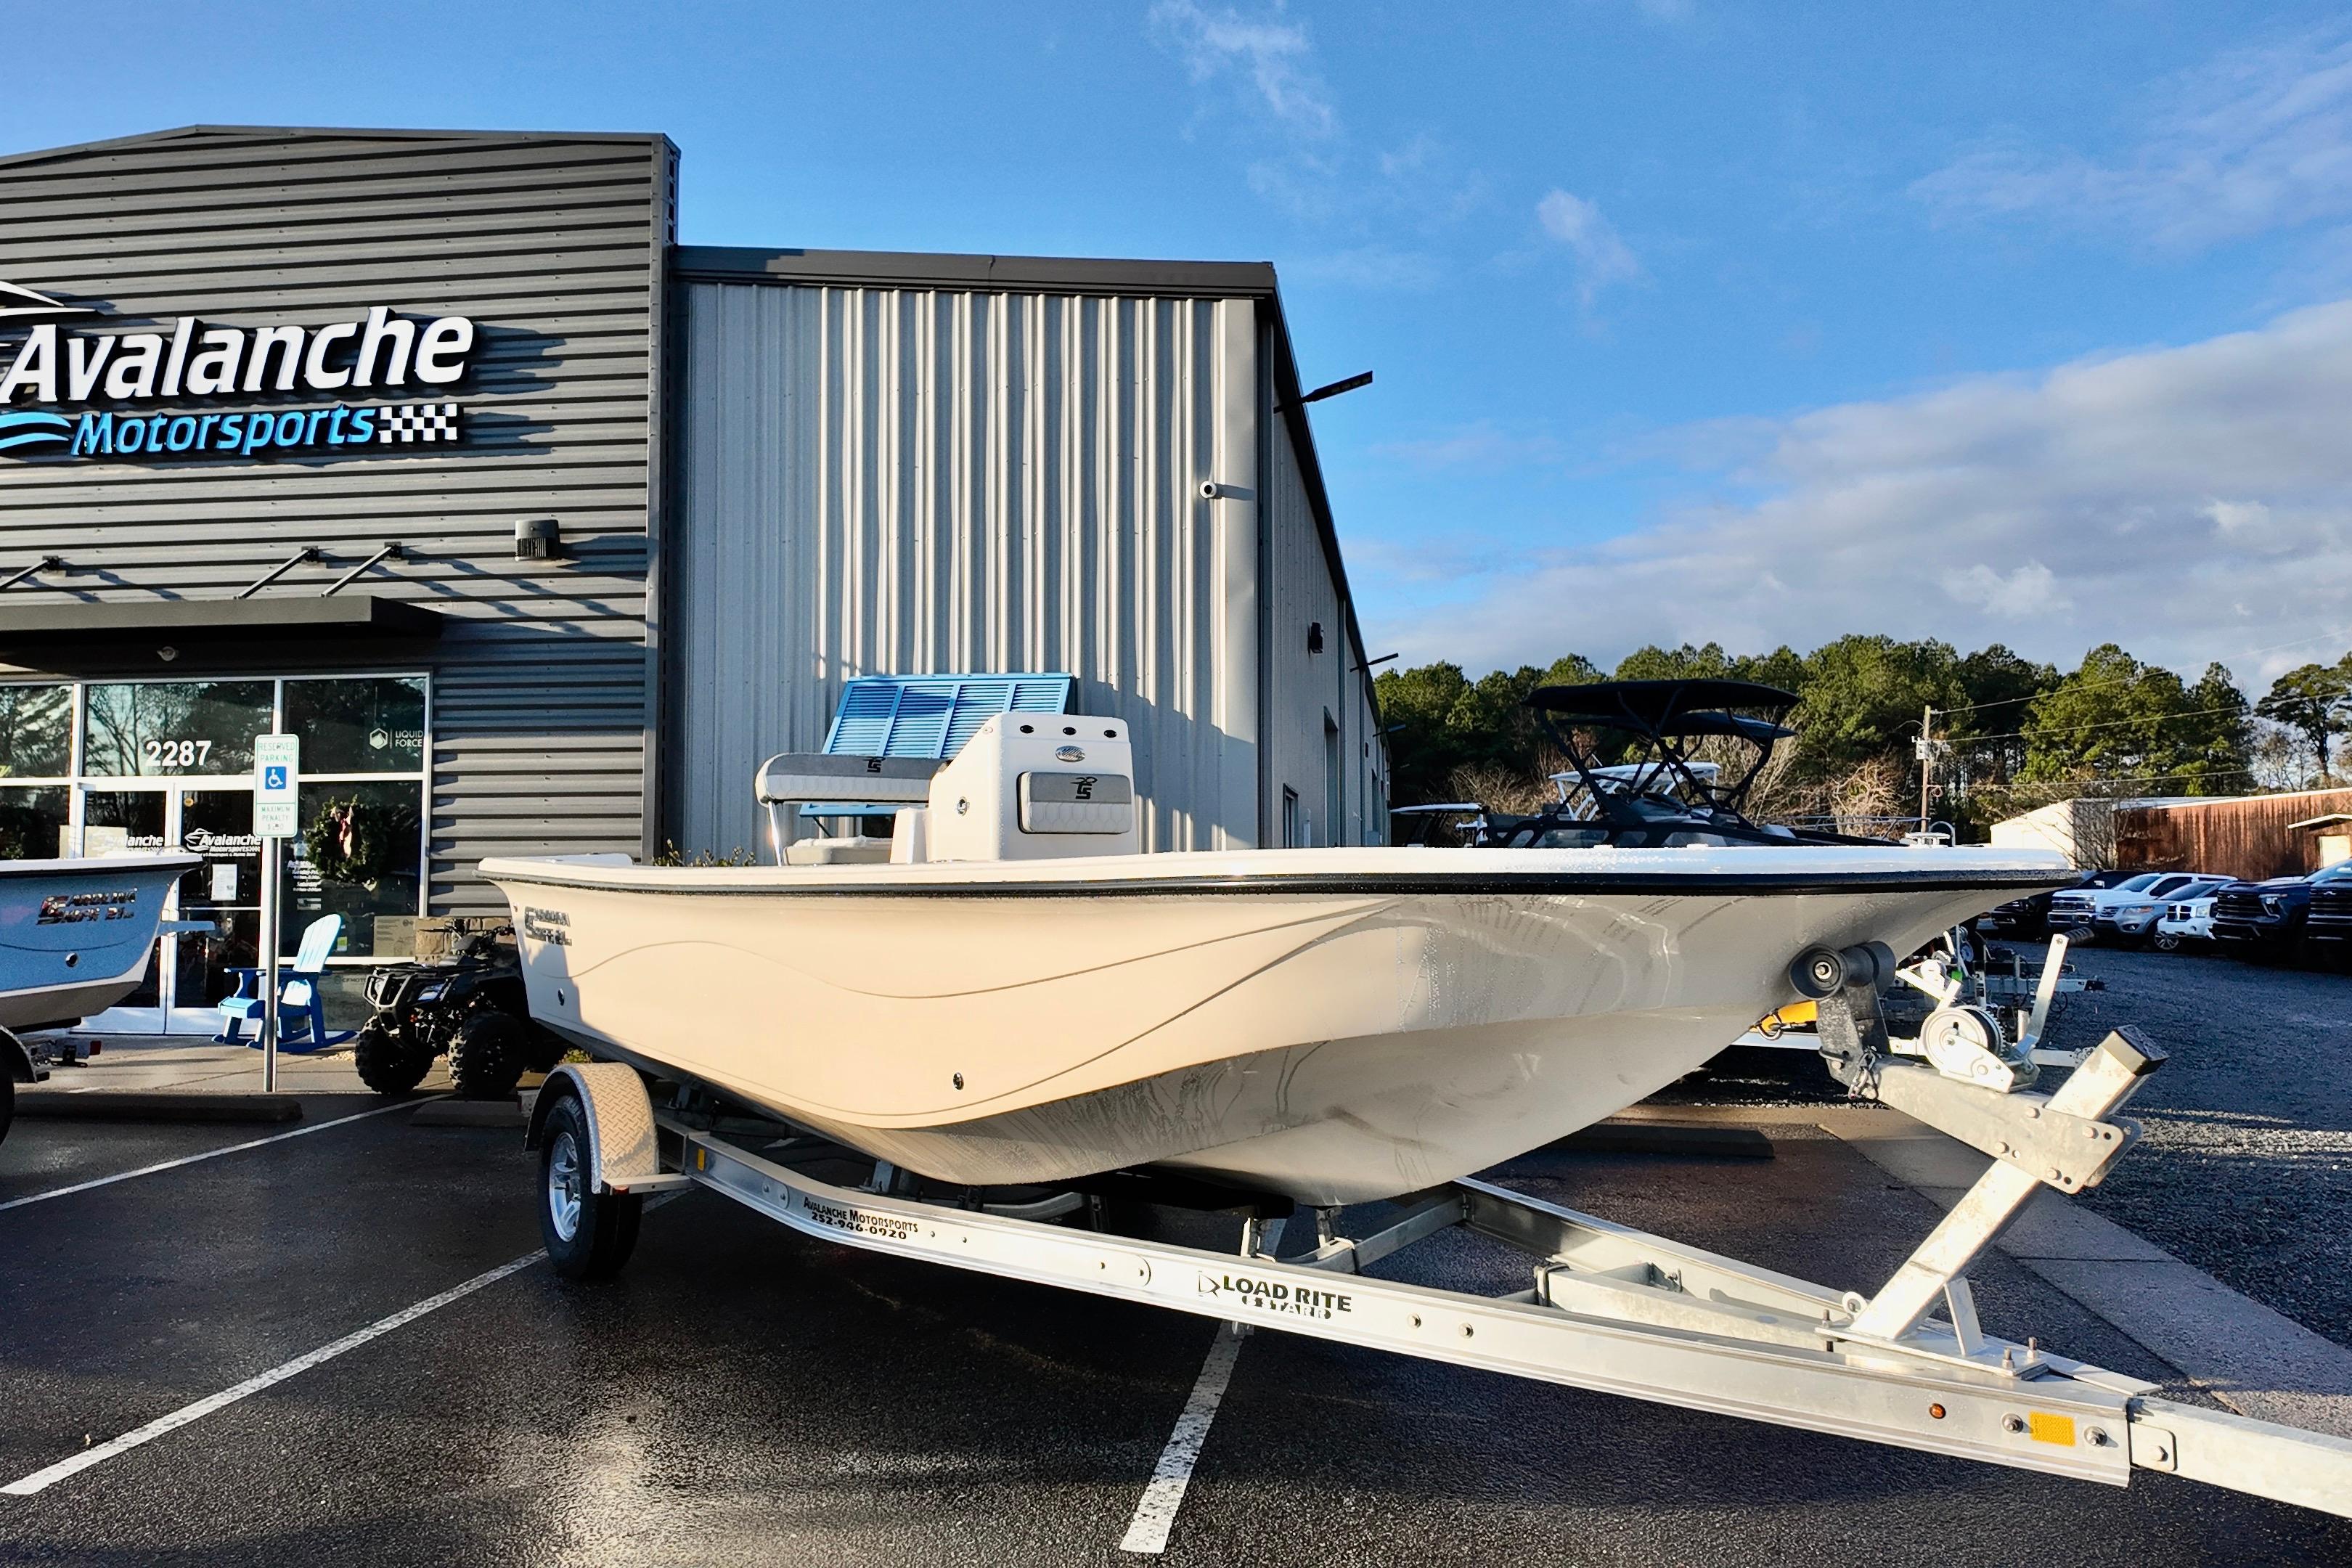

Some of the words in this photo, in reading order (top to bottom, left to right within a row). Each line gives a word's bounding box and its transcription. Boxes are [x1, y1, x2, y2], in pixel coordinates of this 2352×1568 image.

[0, 306, 473, 403] Avalanche
[70, 404, 375, 456] Motorsports
[146, 740, 212, 767] 2287
[258, 743, 295, 751] RESERVED
[198, 834, 261, 846] Avalanche
[811, 1211, 907, 1240] 252-946-0920
[1223, 1275, 1289, 1299] LOAD
[1296, 1287, 1352, 1312] RITE
